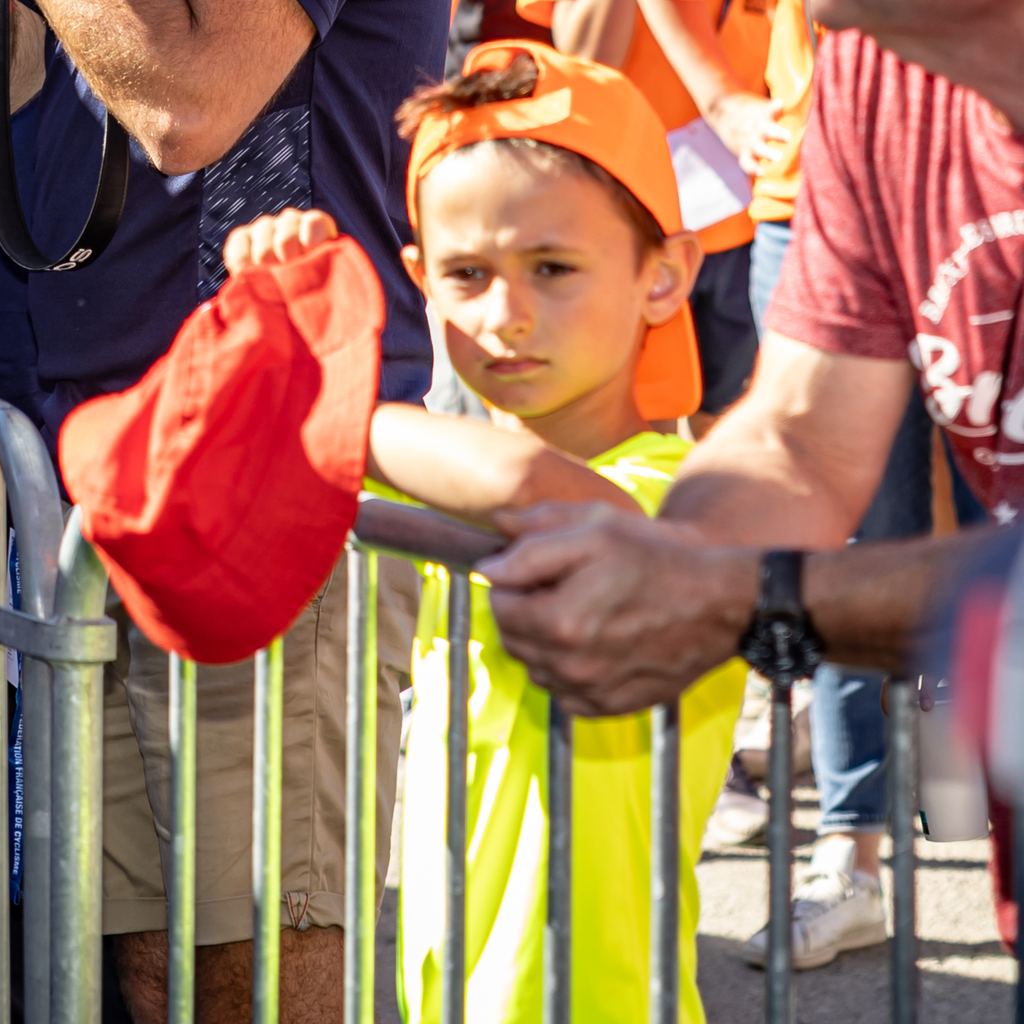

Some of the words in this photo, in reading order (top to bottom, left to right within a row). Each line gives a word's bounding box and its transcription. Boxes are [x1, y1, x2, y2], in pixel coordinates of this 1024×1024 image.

[13, 767, 24, 816] FRANÇAISE
[14, 817, 23, 830] DE
[12, 831, 22, 876] CYCLISME
